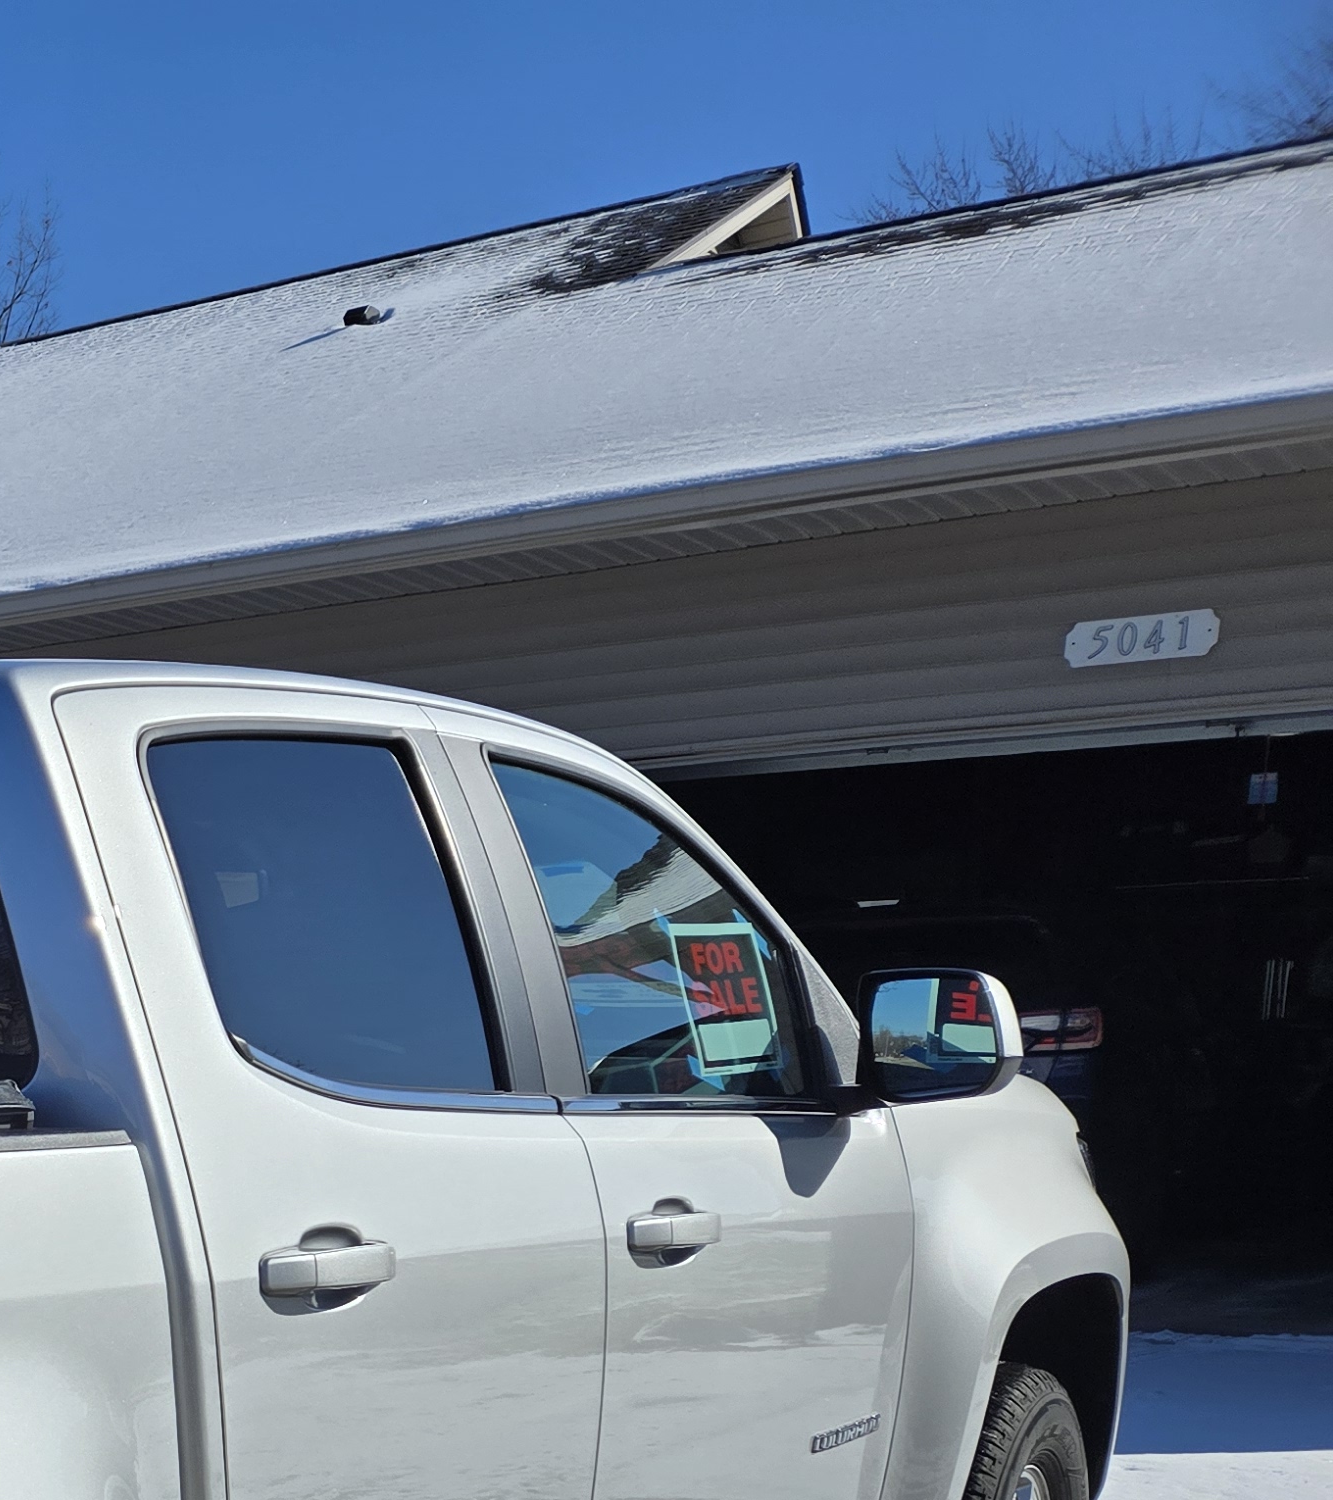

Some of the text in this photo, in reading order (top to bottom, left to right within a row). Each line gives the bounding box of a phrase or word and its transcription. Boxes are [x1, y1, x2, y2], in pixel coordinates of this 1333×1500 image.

[1087, 616, 1190, 660] 5041
[689, 941, 745, 976] FOR
[690, 976, 764, 1017] SALE
